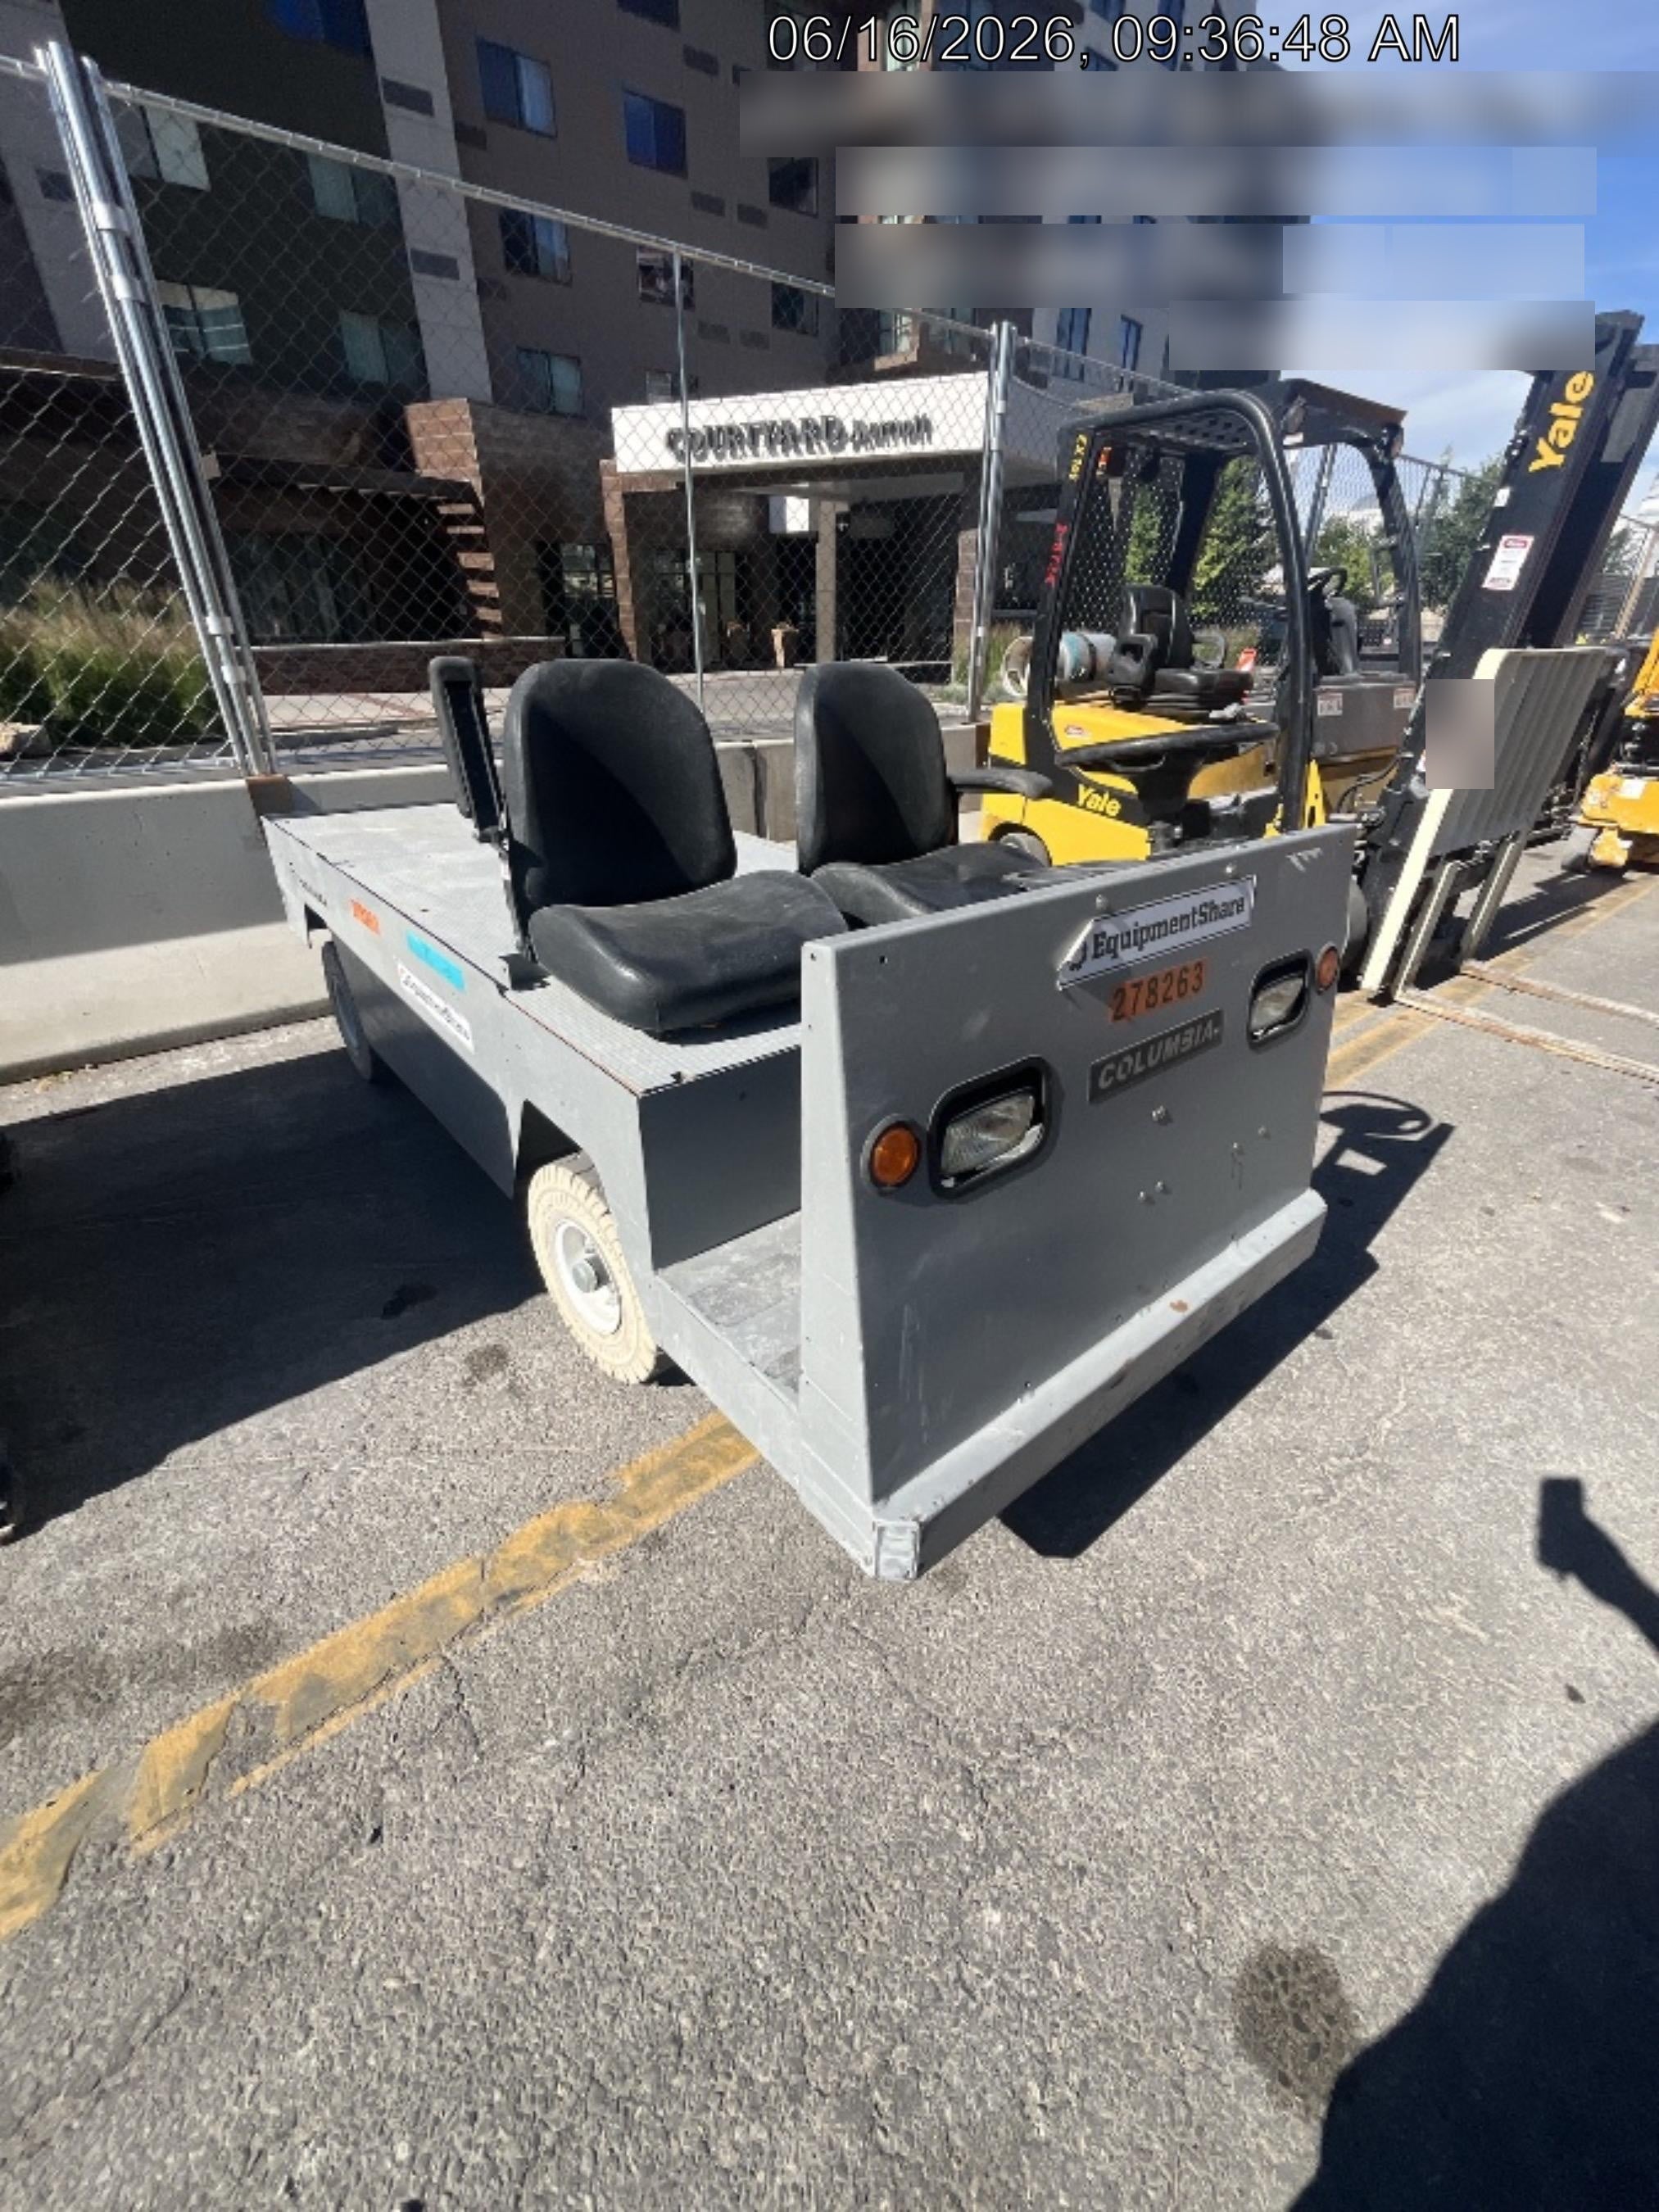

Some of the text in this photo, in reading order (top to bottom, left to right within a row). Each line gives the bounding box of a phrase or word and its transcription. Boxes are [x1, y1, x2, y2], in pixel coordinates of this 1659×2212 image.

[666, 415, 848, 463] COURTYARD
[1528, 370, 1594, 473] Yale
[1078, 783, 1122, 817] Yale
[1091, 896, 1245, 959] EquipmentShare
[1111, 961, 1205, 1022] 278263
[1098, 1019, 1213, 1090] COLUMBIA
